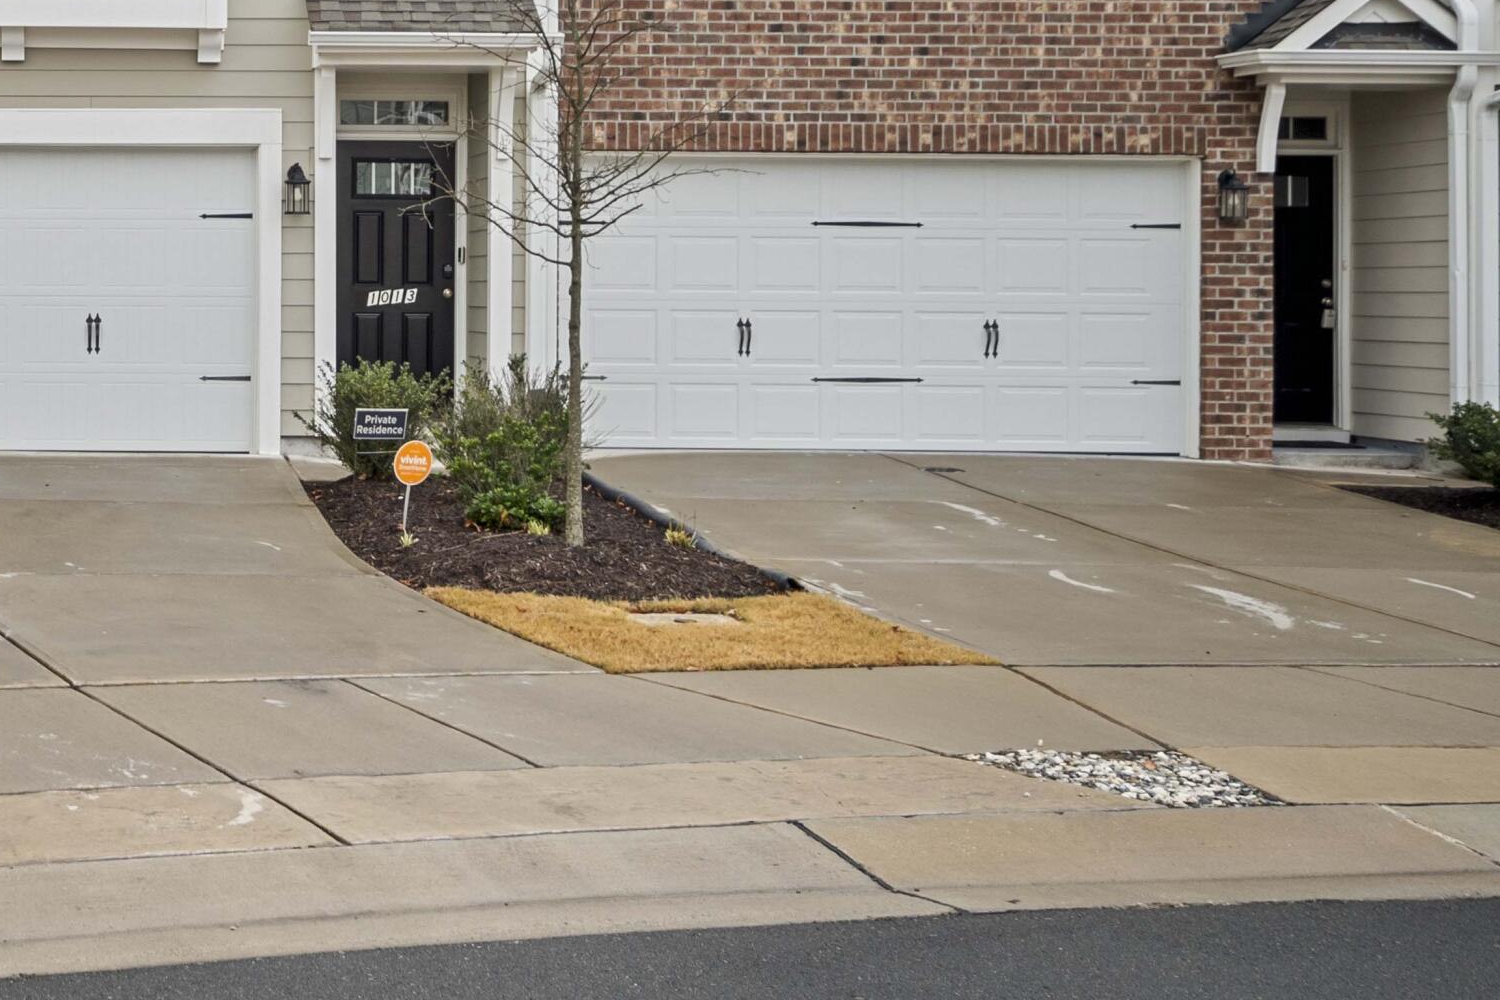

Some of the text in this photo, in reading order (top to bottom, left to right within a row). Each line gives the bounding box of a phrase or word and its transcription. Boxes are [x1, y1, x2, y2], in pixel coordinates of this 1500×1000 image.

[370, 289, 416, 305] 1013
[364, 414, 398, 424] Private
[356, 424, 404, 435] Residence
